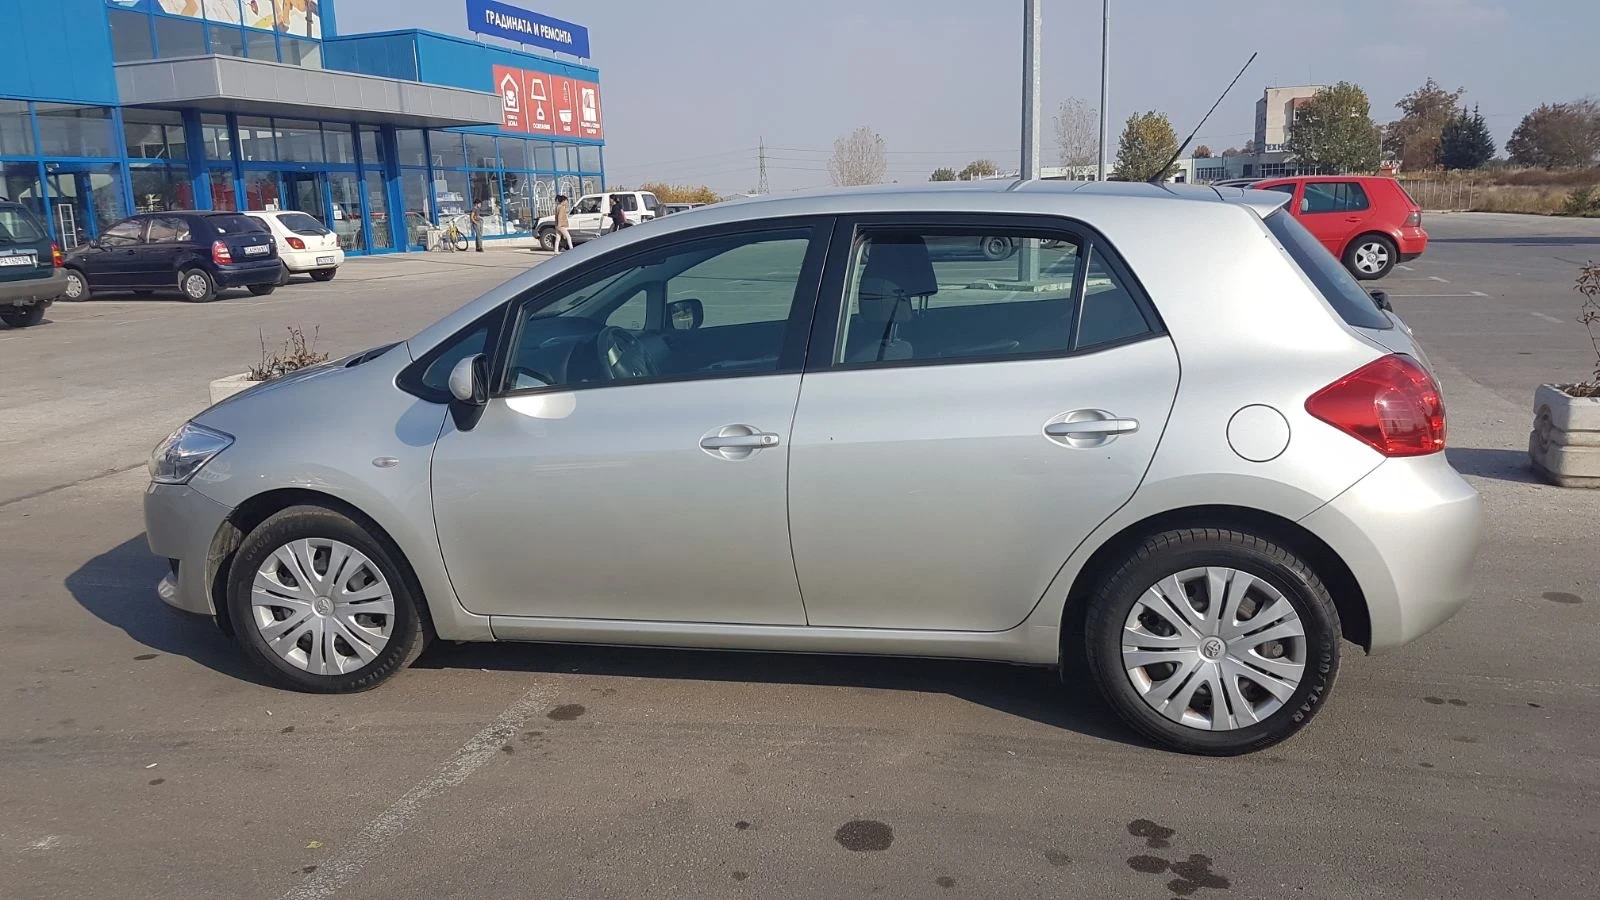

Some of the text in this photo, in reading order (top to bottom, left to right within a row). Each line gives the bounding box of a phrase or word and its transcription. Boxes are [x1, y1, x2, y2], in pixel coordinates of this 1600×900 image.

[485, 10, 573, 46] ГРАДИНАТА И РЕМОНТА
